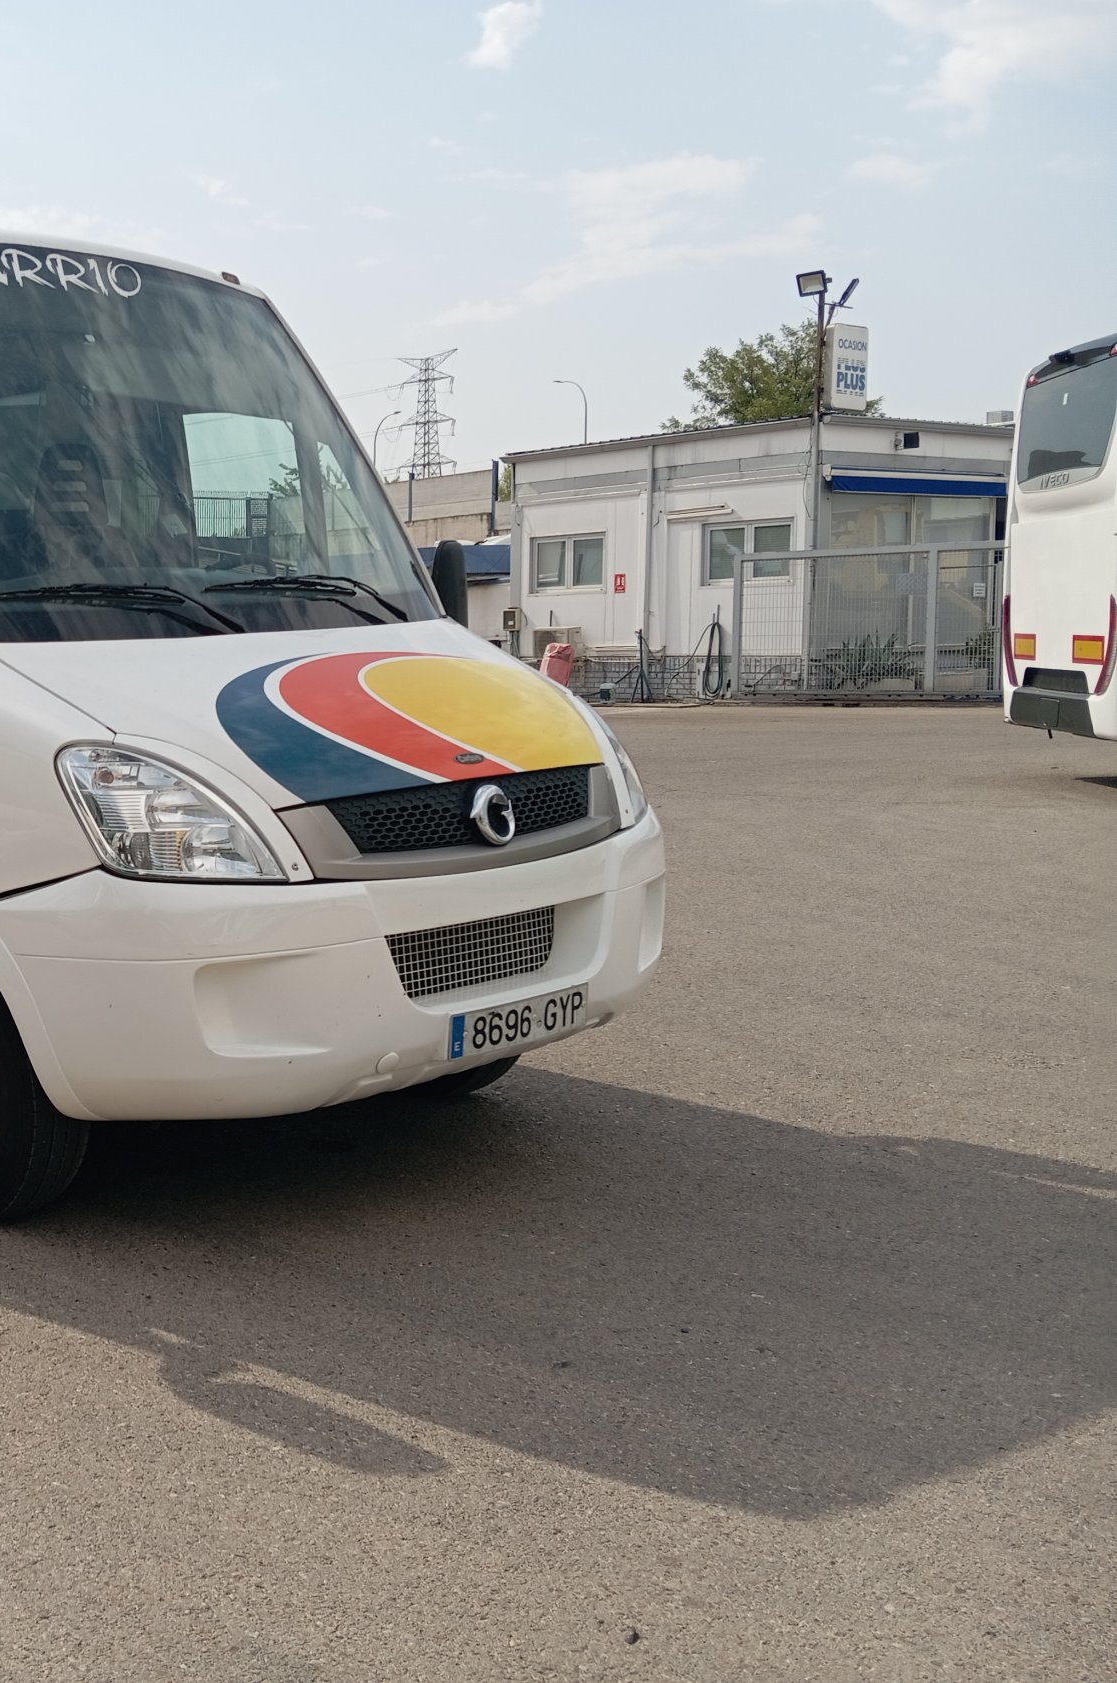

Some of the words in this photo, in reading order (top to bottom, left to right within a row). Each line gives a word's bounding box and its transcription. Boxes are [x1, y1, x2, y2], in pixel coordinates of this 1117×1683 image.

[838, 338, 867, 352] OCASION
[836, 371, 866, 391] PLUS
[1040, 471, 1070, 490] IVECO
[454, 1041, 461, 1051] E
[472, 1005, 532, 1049] 8696
[544, 991, 582, 1031] GYP
